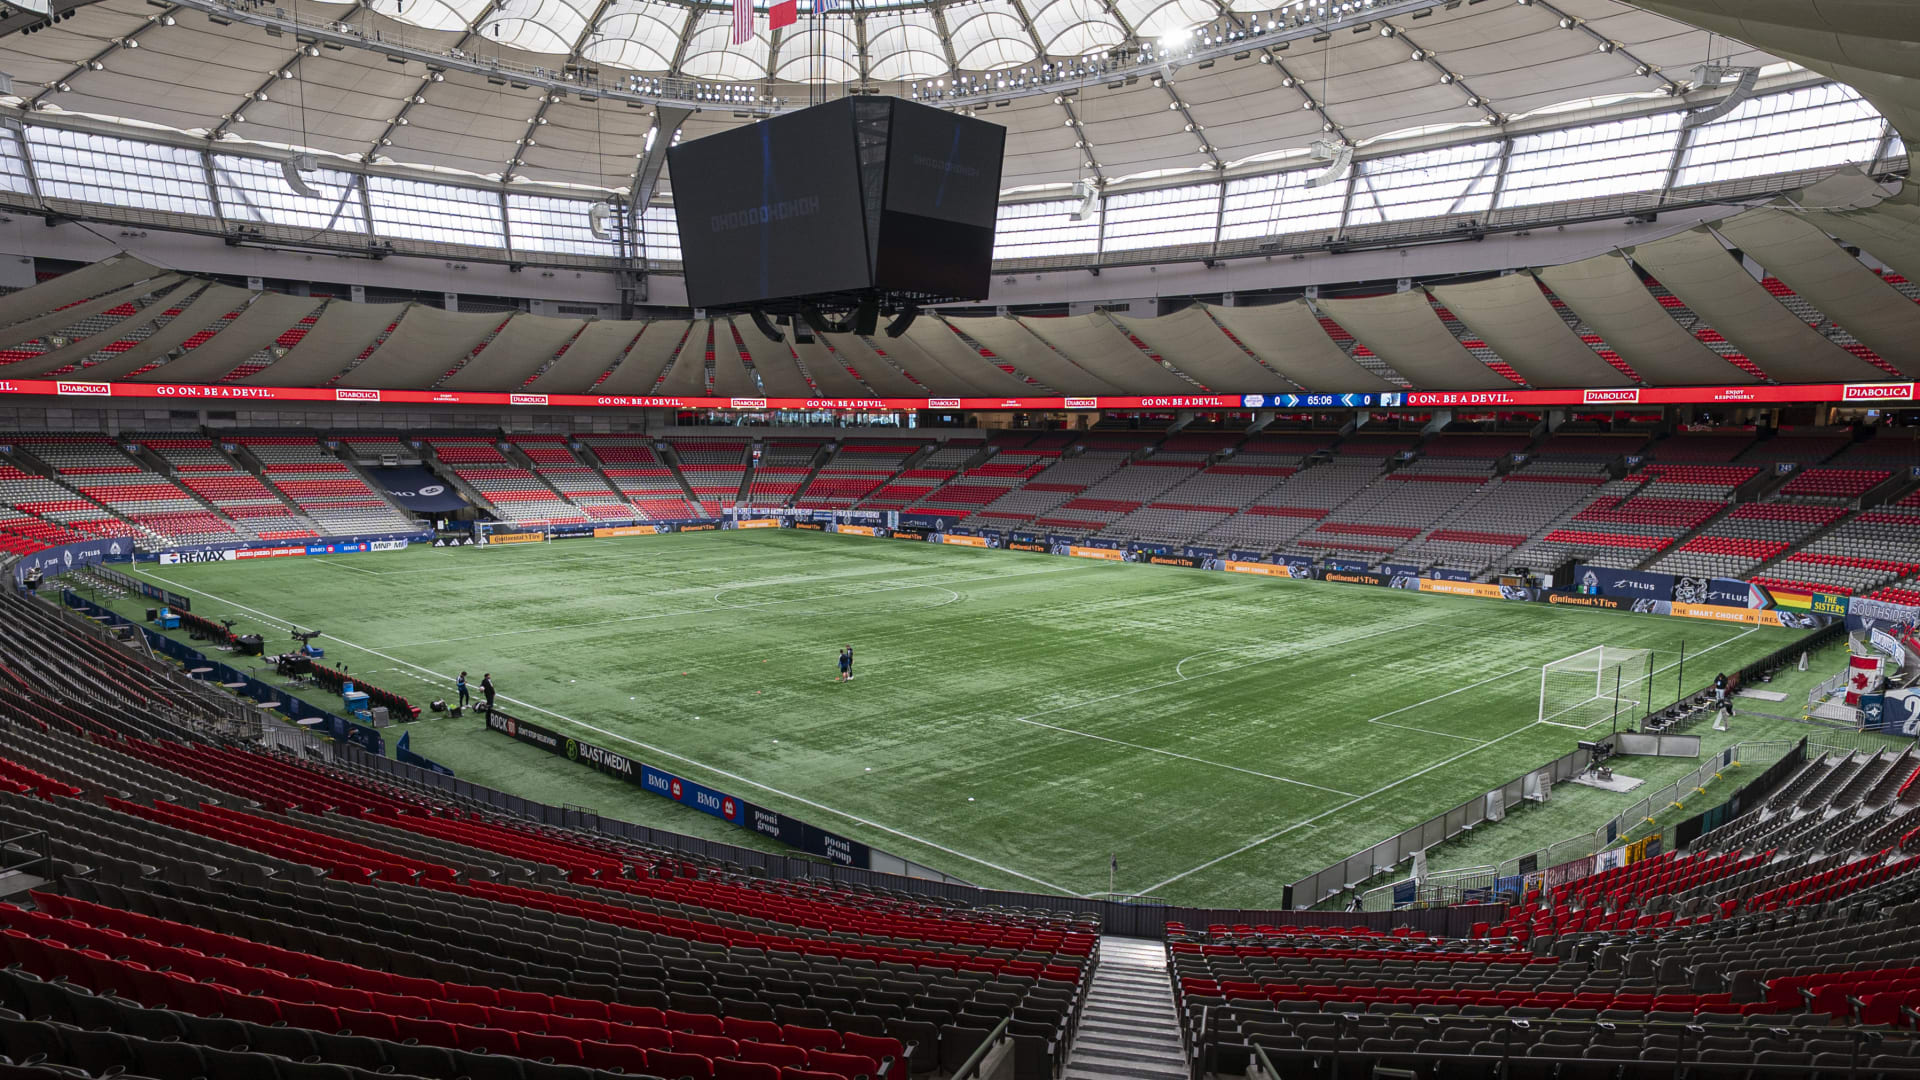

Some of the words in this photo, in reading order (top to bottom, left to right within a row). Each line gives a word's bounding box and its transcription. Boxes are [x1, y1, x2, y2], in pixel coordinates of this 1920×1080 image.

[61, 384, 107, 393] DIABOLICA
[157, 386, 175, 395] GO
[178, 386, 200, 396] ON.
[204, 388, 219, 396] BE
[222, 388, 229, 397] A
[233, 388, 275, 398] DEVIL.
[1848, 386, 1908, 397] DIABOLICA
[340, 391, 376, 399] DIABOLICA
[513, 396, 546, 404] DIABOLICA
[1364, 395, 1370, 406] 0
[1408, 394, 1416, 404] O
[1420, 394, 1440, 404] ON.
[1444, 394, 1457, 402] BE
[1460, 394, 1468, 402] A
[1472, 394, 1514, 402] DEVIL.
[1588, 392, 1634, 400] DIABOLICA
[598, 397, 612, 405] GO
[1193, 398, 1223, 406] DEVIL.
[1274, 396, 1280, 406] 0
[1308, 396, 1332, 406] 65:06
[1326, 573, 1358, 582] Continental
[1364, 576, 1378, 584] Tire
[1628, 582, 1655, 590] TELUS
[1549, 594, 1592, 605] Continental
[1599, 598, 1618, 608] Tire
[1721, 592, 1748, 602] TELUS
[1824, 595, 1837, 604] THE
[1814, 602, 1844, 614] SISTERS
[1715, 612, 1744, 620] CHOICE
[490, 713, 508, 732] ROCK
[580, 744, 603, 763] BLAST
[604, 754, 632, 775] MEDIA
[648, 774, 668, 790] BMO
[698, 791, 720, 810] BMO
[755, 810, 778, 824] pooni
[757, 820, 780, 836] group
[824, 836, 850, 852] pooni
[827, 846, 852, 864] group
